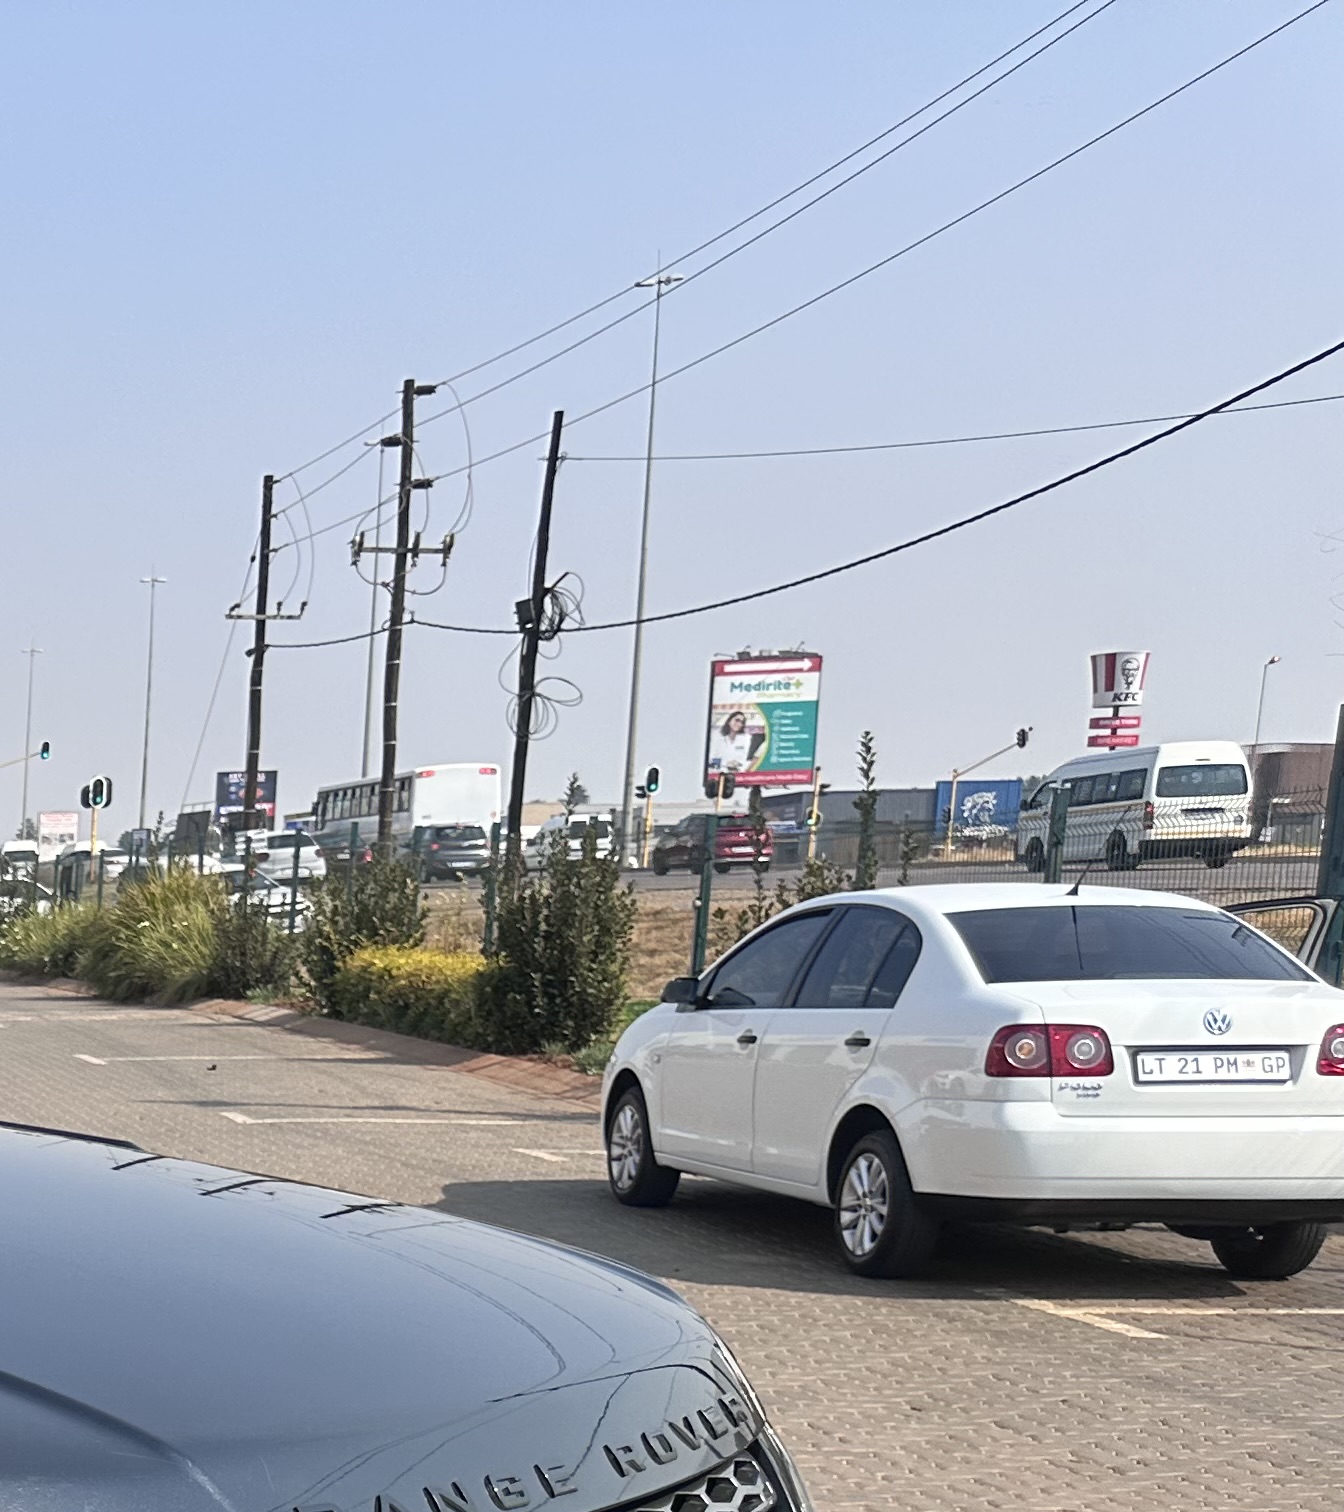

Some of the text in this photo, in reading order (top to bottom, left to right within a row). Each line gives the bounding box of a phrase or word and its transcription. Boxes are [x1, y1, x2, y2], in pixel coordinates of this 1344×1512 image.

[1112, 691, 1139, 702] KFC
[1141, 1056, 1286, 1075] LT 21 PM GP
[602, 1393, 755, 1477] ROVER
